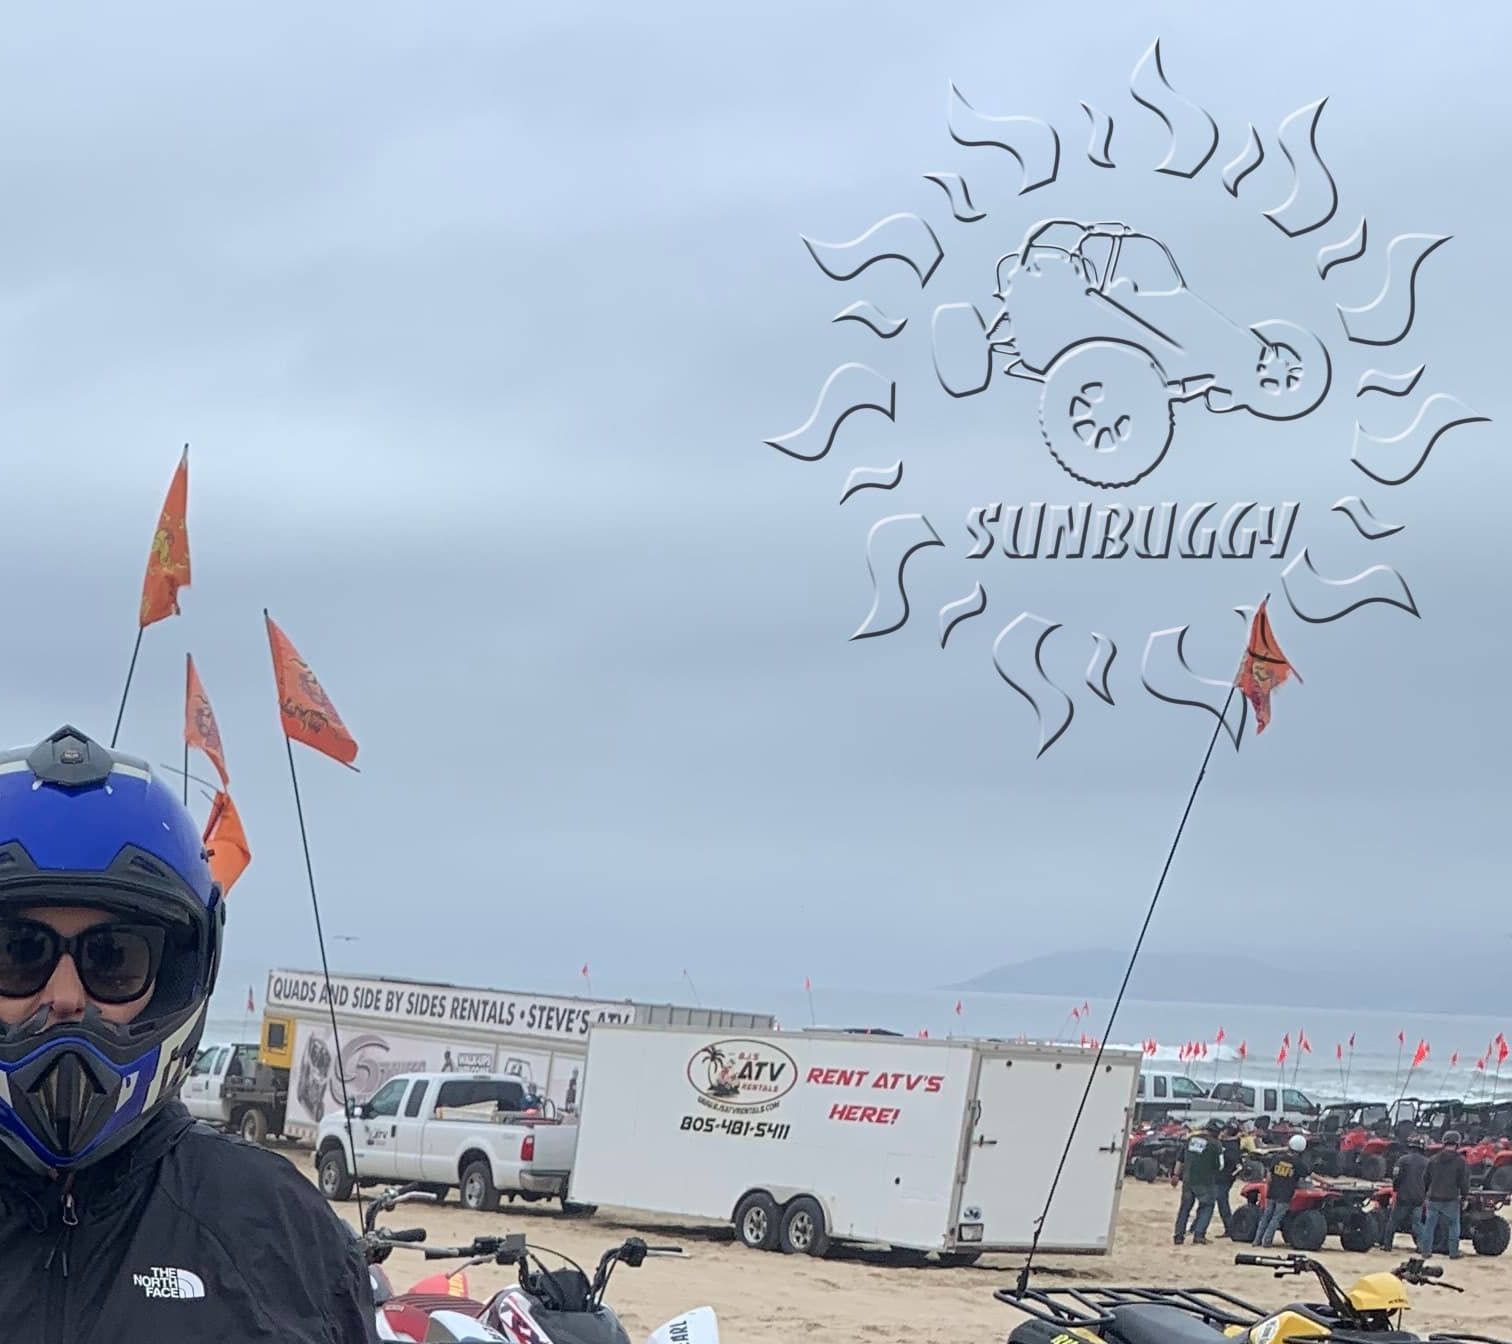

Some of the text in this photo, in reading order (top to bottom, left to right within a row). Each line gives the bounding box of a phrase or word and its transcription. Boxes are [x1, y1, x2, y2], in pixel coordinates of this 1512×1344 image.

[273, 976, 317, 1002] QUADS
[319, 981, 348, 1007] AND
[352, 986, 381, 1011] SIDE
[385, 990, 404, 1013] BY
[406, 992, 446, 1018] SIDES
[449, 997, 515, 1026] RENTALS
[527, 1009, 589, 1034] STEVE'S
[737, 1061, 786, 1081] ATV
[806, 1067, 944, 1093] RENT ATV'S
[741, 1084, 779, 1093] RENTALS
[828, 1104, 901, 1125] HERE!
[680, 1116, 791, 1140] 805-481-5411
[133, 1274, 178, 1288] NORTH
[150, 1267, 177, 1278] THE
[146, 1288, 179, 1298] FACE
